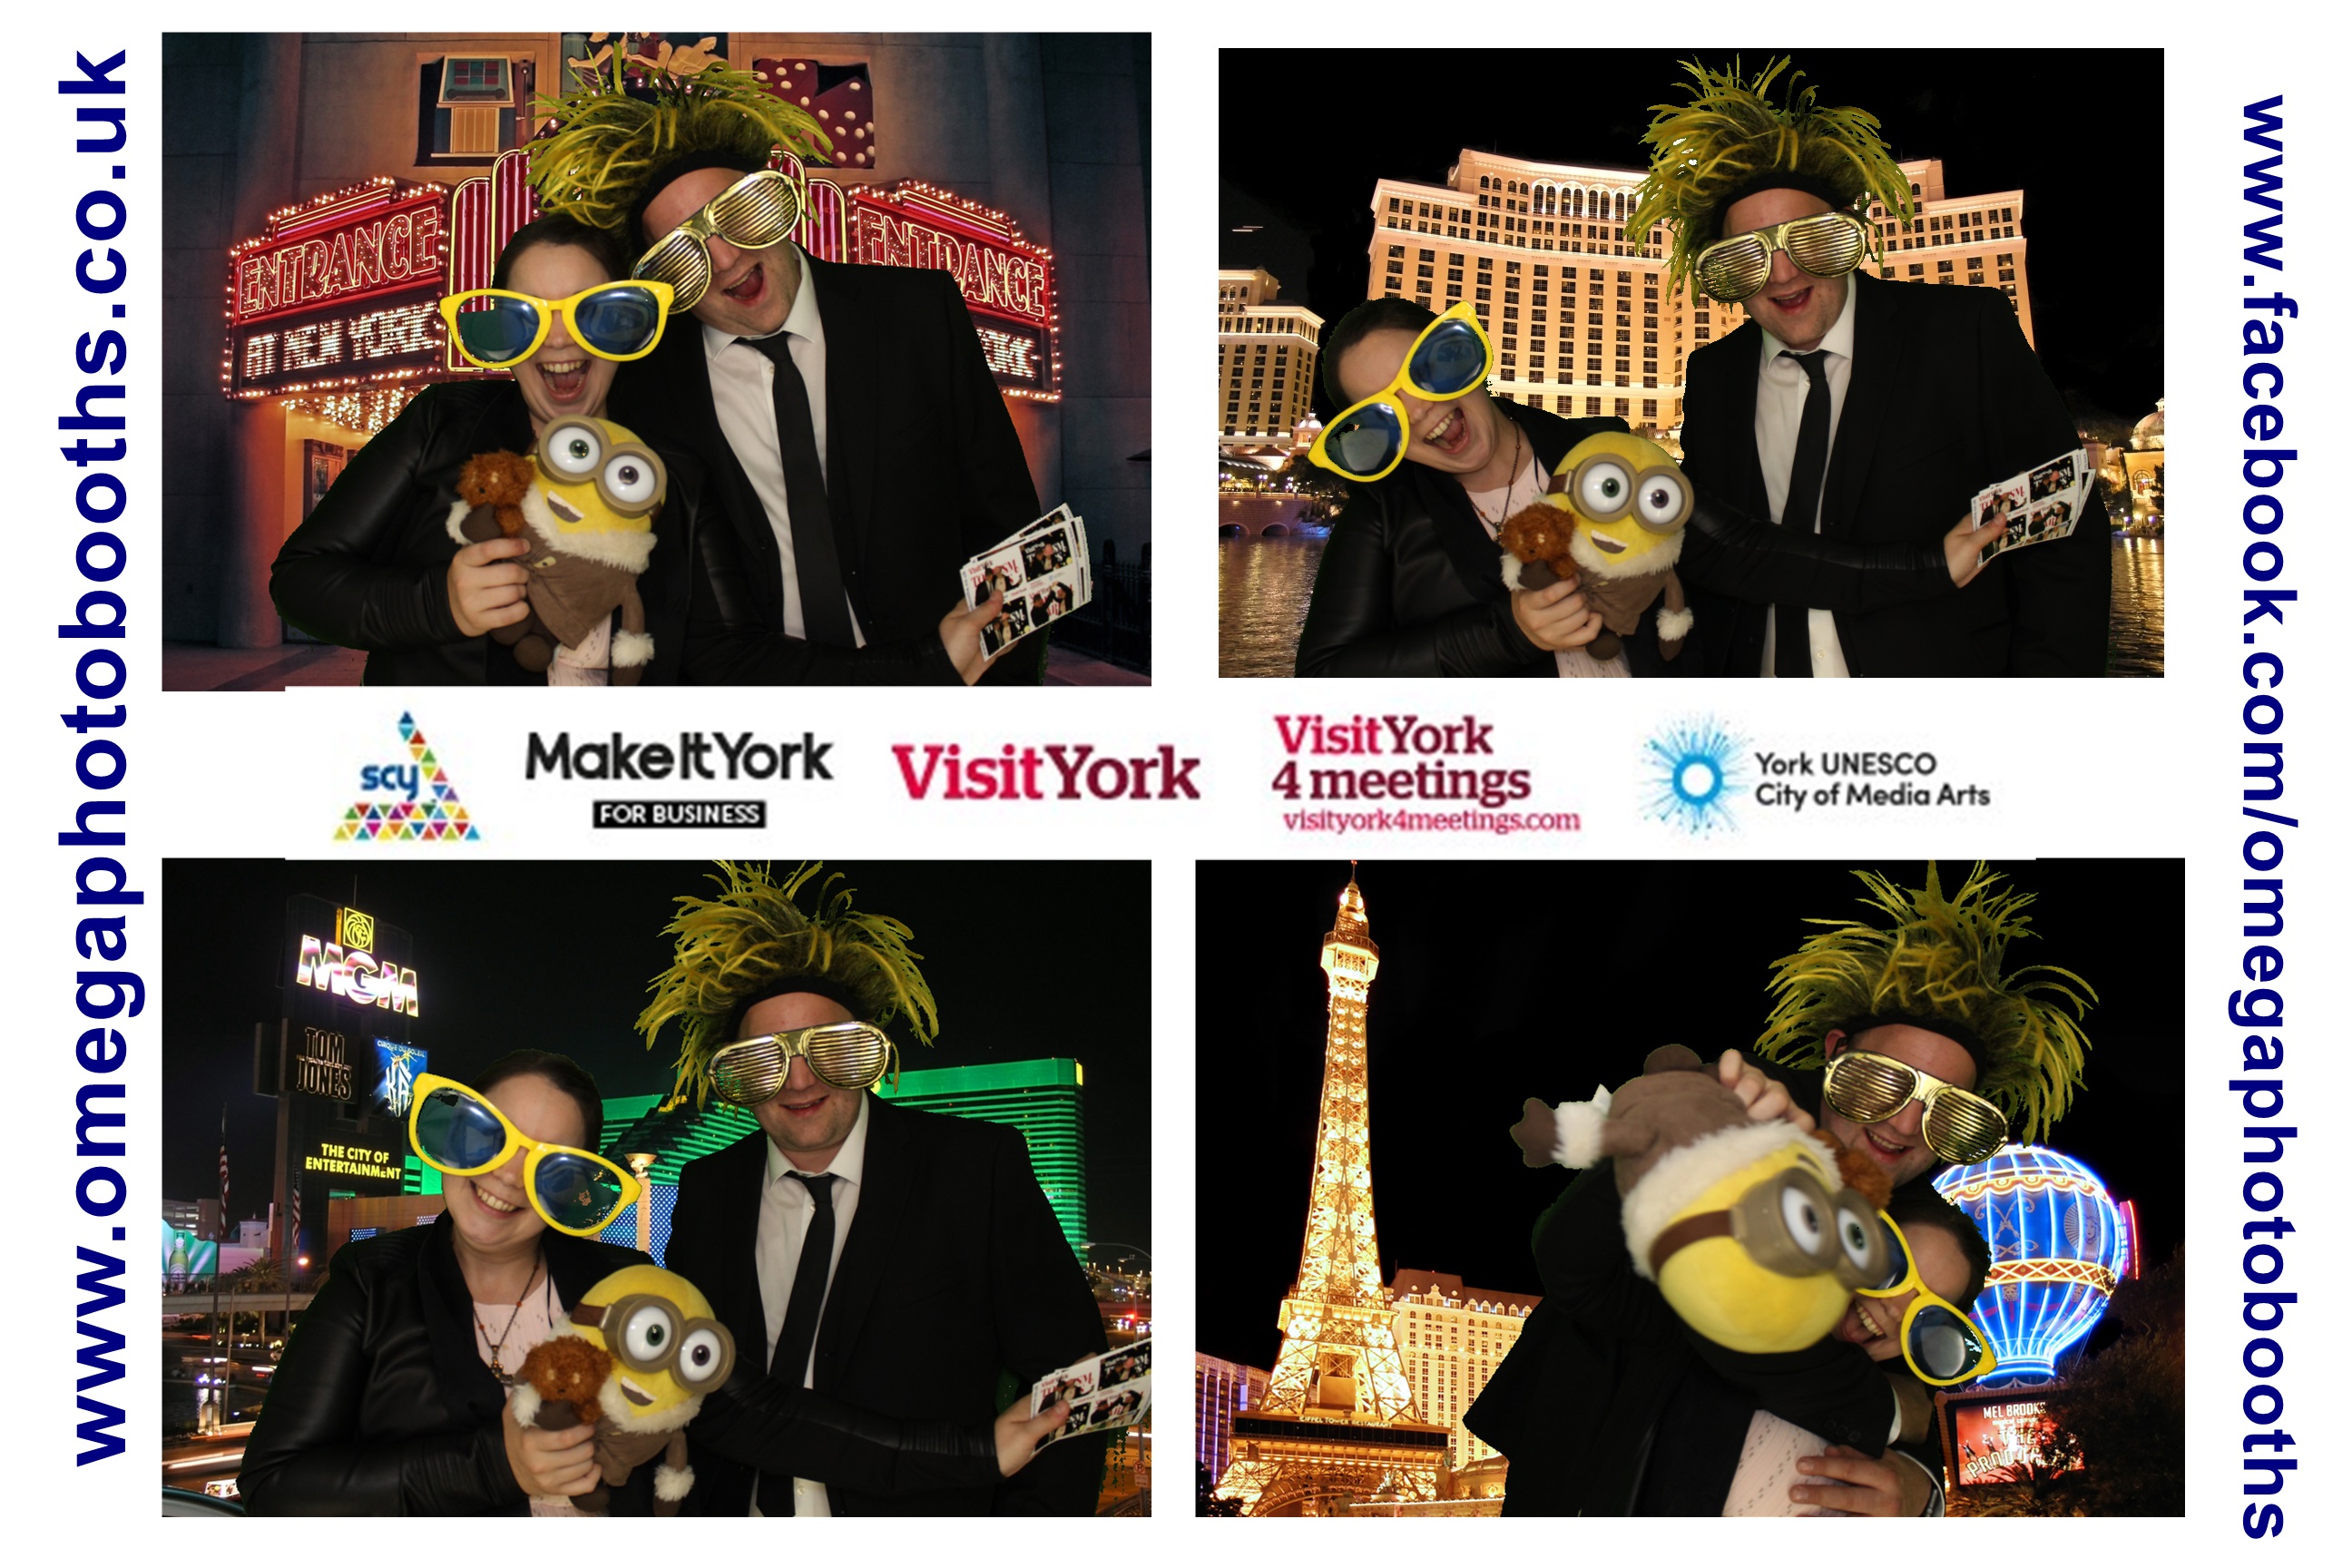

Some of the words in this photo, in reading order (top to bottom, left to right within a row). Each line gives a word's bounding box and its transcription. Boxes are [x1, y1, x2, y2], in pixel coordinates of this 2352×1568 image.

[240, 206, 437, 315] ENTRANCE
[296, 934, 419, 1018] MGM
[305, 1026, 346, 1063] TOM
[377, 1040, 397, 1052] CIRQUE
[296, 1061, 352, 1101] JONES
[321, 1143, 345, 1159] THE
[347, 1147, 372, 1161] CITY
[374, 1151, 389, 1164] OF
[1325, 1416, 1349, 1426] TOWER
[1351, 1419, 1394, 1428] RESTAURANT
[1984, 1406, 2004, 1420] MEL
[1998, 1427, 2036, 1446] THE
